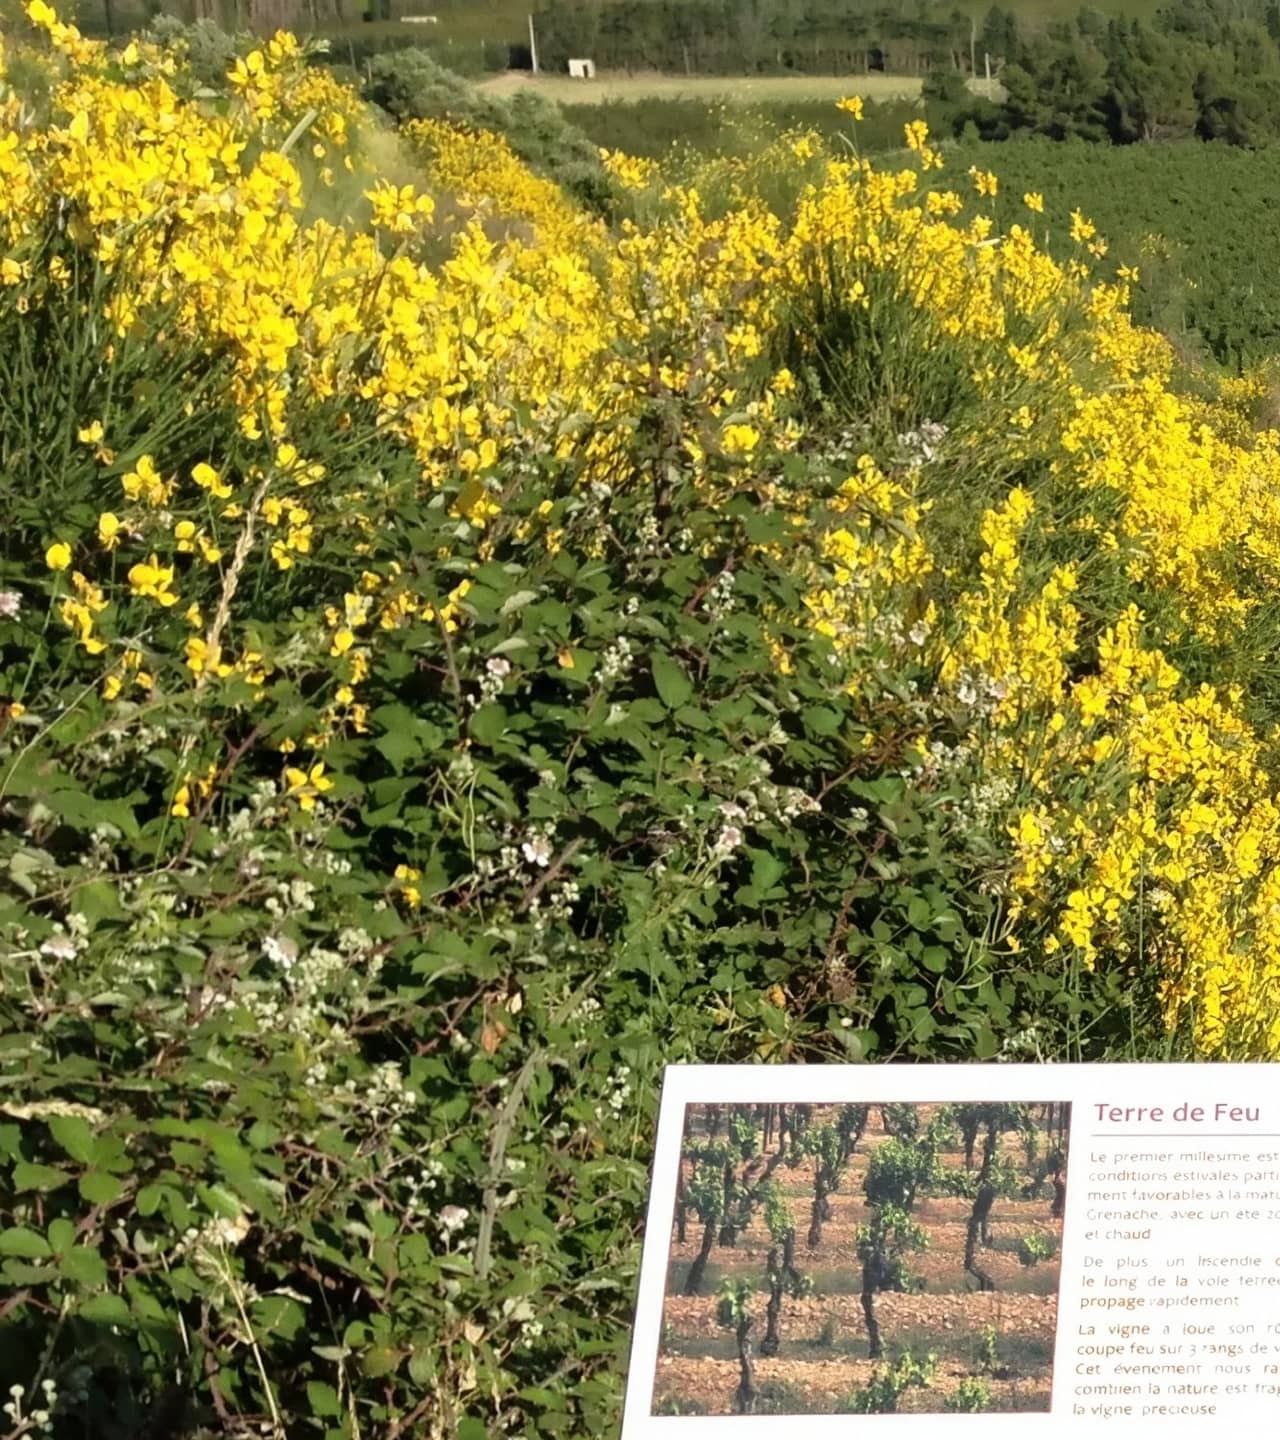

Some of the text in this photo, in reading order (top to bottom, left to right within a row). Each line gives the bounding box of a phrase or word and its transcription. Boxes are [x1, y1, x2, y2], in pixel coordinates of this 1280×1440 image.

[1094, 1101, 1261, 1123] Terre de Feu
[1090, 1151, 1107, 1164] Le
[1113, 1151, 1174, 1166] premier
[1256, 1151, 1279, 1162] est
[1088, 1169, 1168, 1183] conditions
[1172, 1168, 1239, 1182] estivales
[1087, 1190, 1127, 1201] ment
[1228, 1189, 1241, 1201] la
[1169, 1209, 1204, 1221] avec
[1209, 1209, 1229, 1221] un
[1084, 1229, 1099, 1241] et
[1083, 1255, 1104, 1268] De
[1166, 1256, 1185, 1268] un
[1081, 1275, 1096, 1288] le
[1103, 1275, 1138, 1292] long
[1147, 1276, 1166, 1288] de
[1175, 1275, 1189, 1288] la
[1198, 1275, 1230, 1288] voie
[1078, 1323, 1096, 1336] La
[1107, 1323, 1151, 1339] vigne
[1228, 1324, 1256, 1336] son
[1077, 1343, 1125, 1357] coupe
[1129, 1341, 1154, 1355] feu
[1159, 1342, 1184, 1355] sur
[1189, 1343, 1197, 1358] 3
[1249, 1341, 1269, 1355] de
[1074, 1362, 1102, 1376] Cet
[1214, 1362, 1252, 1375] nous
[1148, 1382, 1161, 1396] la
[1167, 1382, 1218, 1396] nature
[1225, 1382, 1249, 1395] est
[1072, 1402, 1086, 1416] la
[1090, 1402, 1133, 1419] vigne
